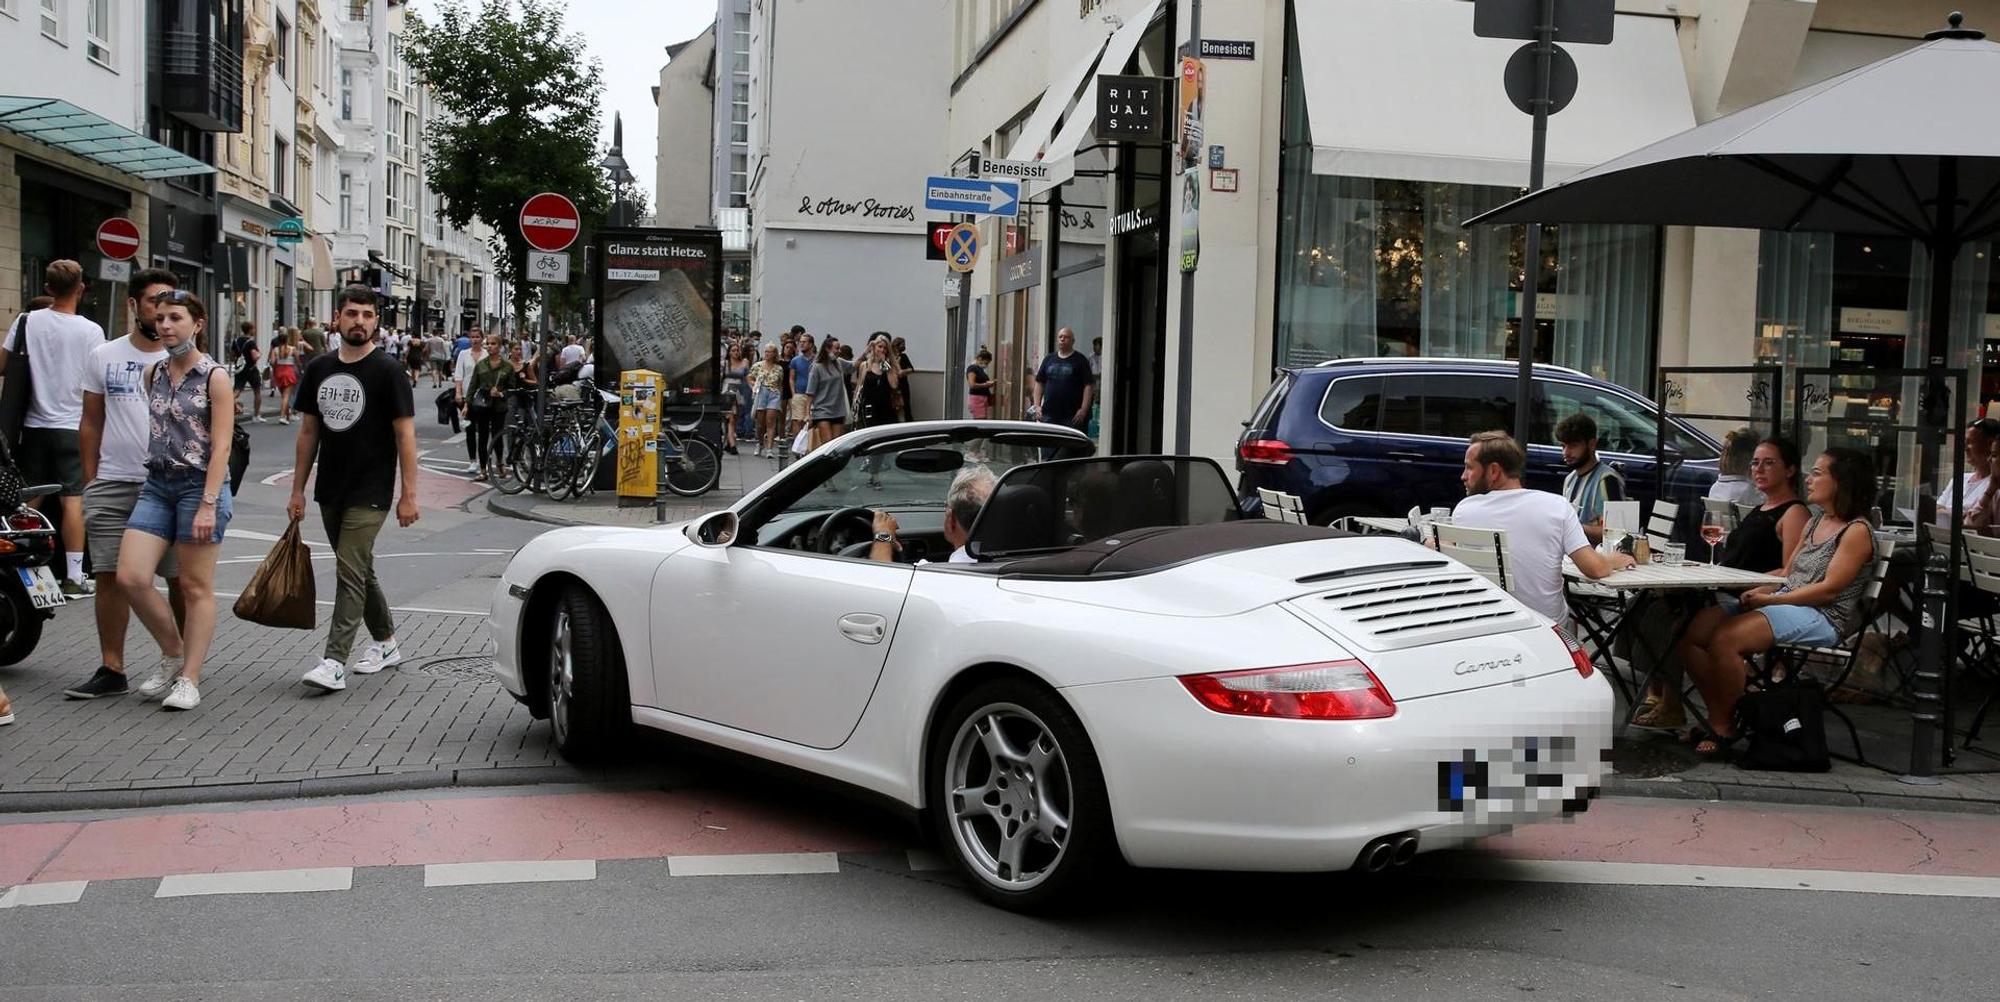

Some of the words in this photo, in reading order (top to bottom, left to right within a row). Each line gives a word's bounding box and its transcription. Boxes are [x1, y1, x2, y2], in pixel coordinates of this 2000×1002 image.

[1202, 41, 1251, 55] Benesisstr.
[983, 160, 1047, 177] Benesisstr
[930, 189, 992, 202] Einbahnstraße
[798, 196, 814, 216] &
[816, 197, 862, 216] other
[863, 198, 915, 222] Stories
[608, 244, 640, 256] Glanz
[641, 246, 669, 257] statt
[670, 246, 707, 258] Hetze.
[541, 271, 556, 279] frei
[634, 271, 657, 280] August
[33, 594, 50, 607] DX
[50, 593, 65, 605] 44
[1454, 658, 1512, 676] Carrera
[1513, 653, 1522, 664] 4
